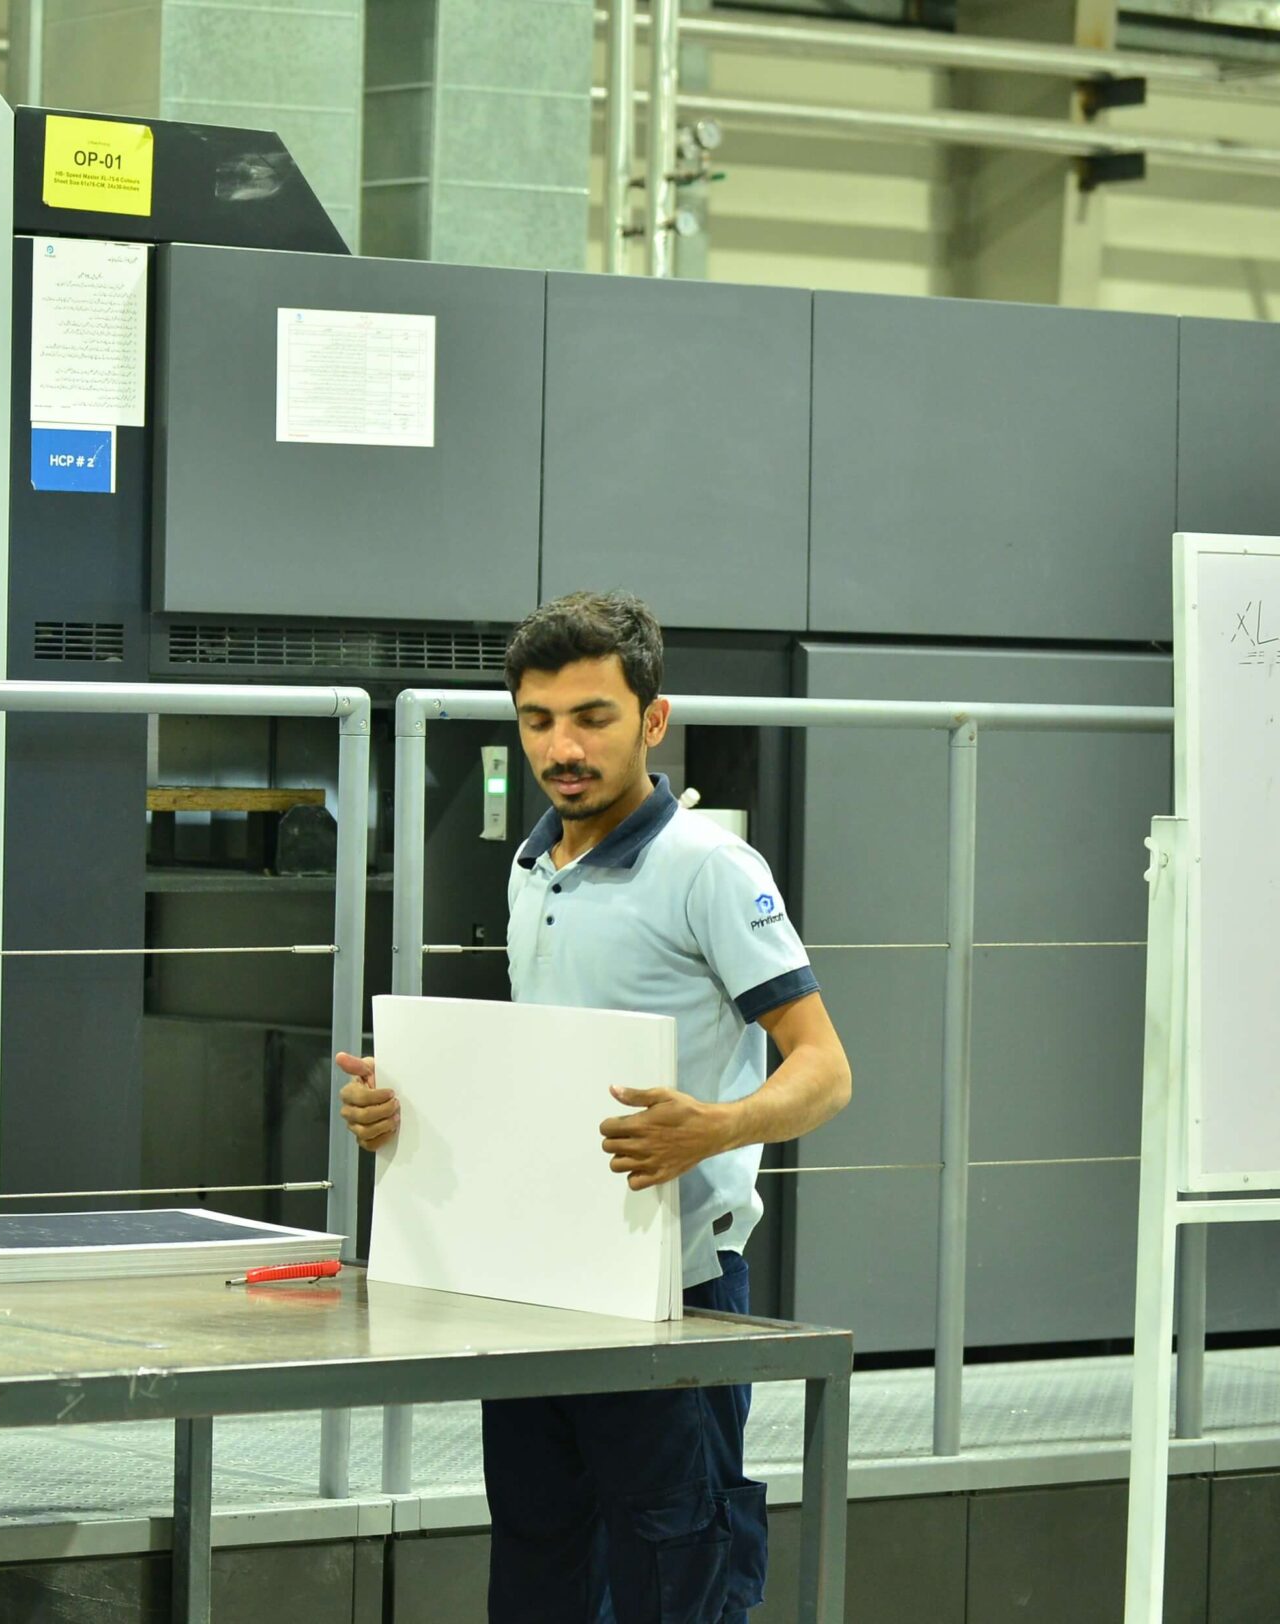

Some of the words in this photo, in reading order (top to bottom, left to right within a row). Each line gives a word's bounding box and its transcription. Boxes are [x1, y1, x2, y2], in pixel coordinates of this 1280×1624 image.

[74, 150, 122, 170] OP-01
[66, 171, 81, 179] Speed
[82, 172, 99, 181] Master
[50, 454, 74, 467] HCP
[76, 455, 85, 468] #
[87, 458, 95, 468] 2
[1231, 600, 1279, 646] XL
